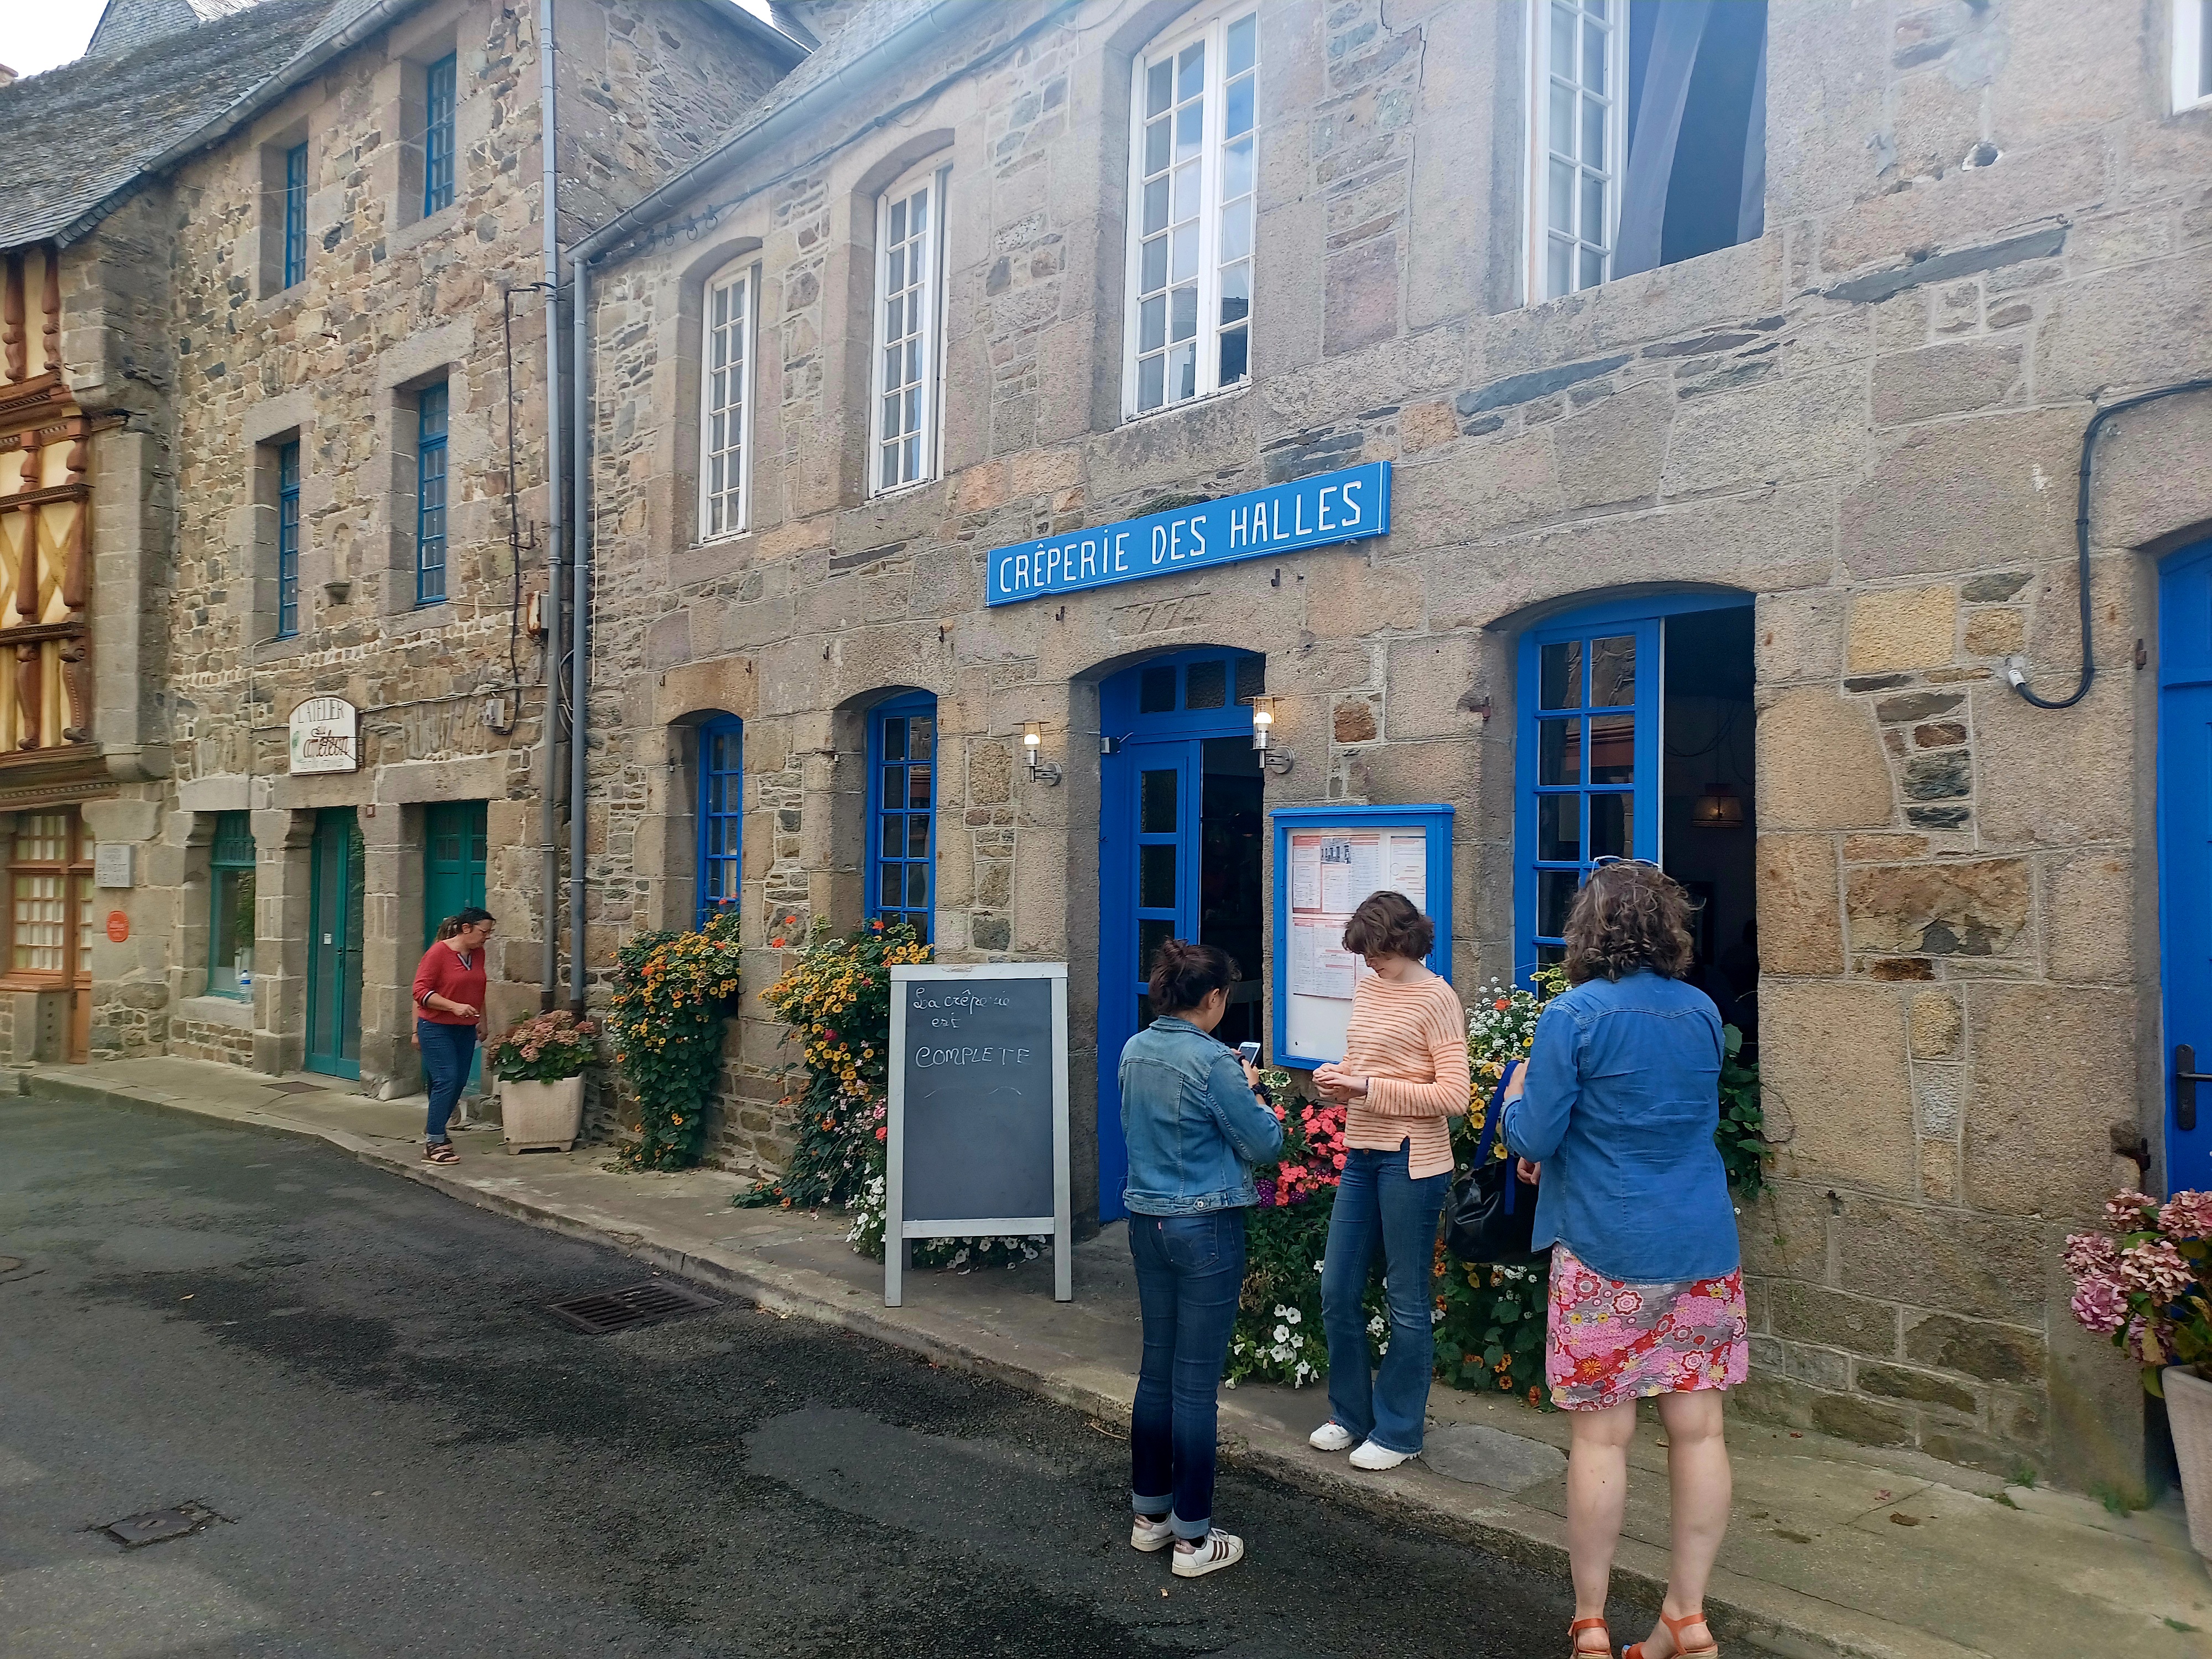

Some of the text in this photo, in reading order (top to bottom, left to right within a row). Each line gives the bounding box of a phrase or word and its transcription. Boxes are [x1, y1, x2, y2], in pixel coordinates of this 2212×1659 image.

[1151, 515, 1207, 565] DES
[1230, 481, 1362, 549] HALLES
[913, 987, 941, 1009] La
[931, 1013, 961, 1029] est
[915, 1046, 1030, 1068] COMPLETE
